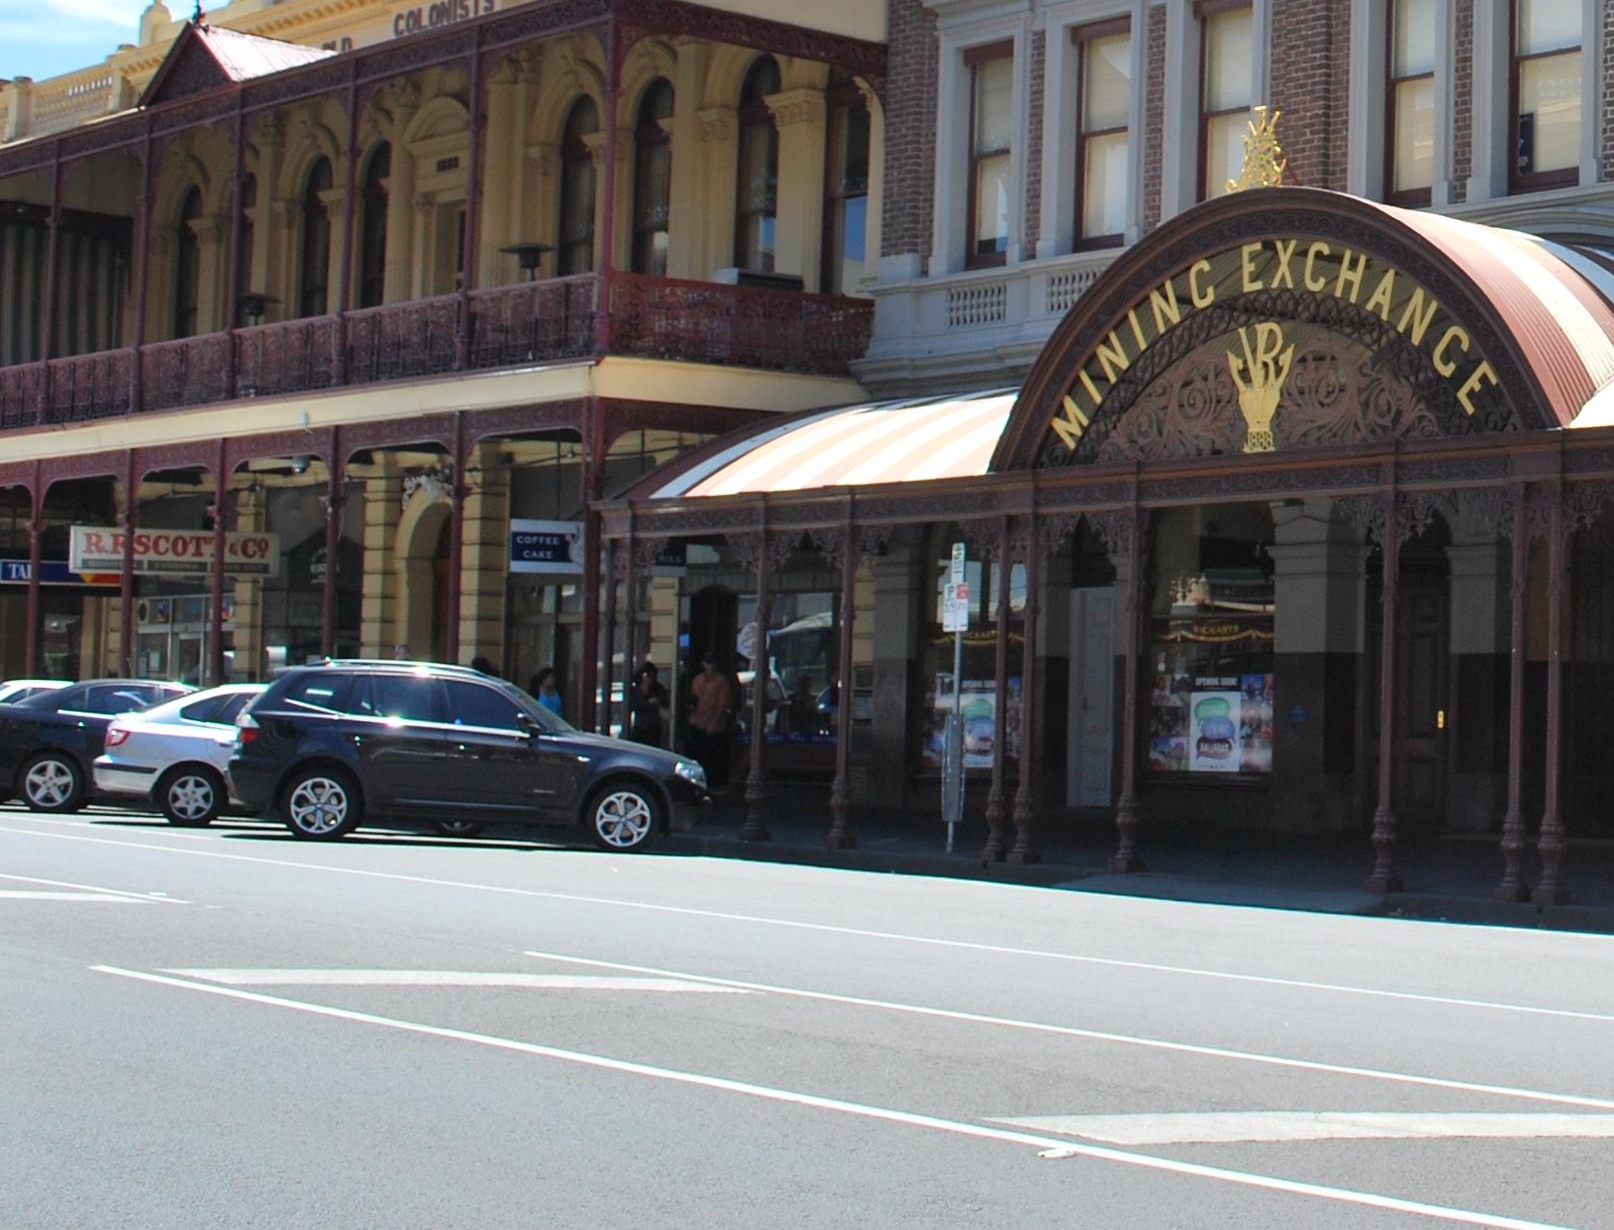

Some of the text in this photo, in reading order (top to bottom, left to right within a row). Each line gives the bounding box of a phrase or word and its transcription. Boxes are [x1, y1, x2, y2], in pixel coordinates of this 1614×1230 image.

[1051, 239, 1498, 450] MINING EXCHANGE
[516, 535, 560, 545] COFFEE
[523, 550, 553, 559] CAKE
